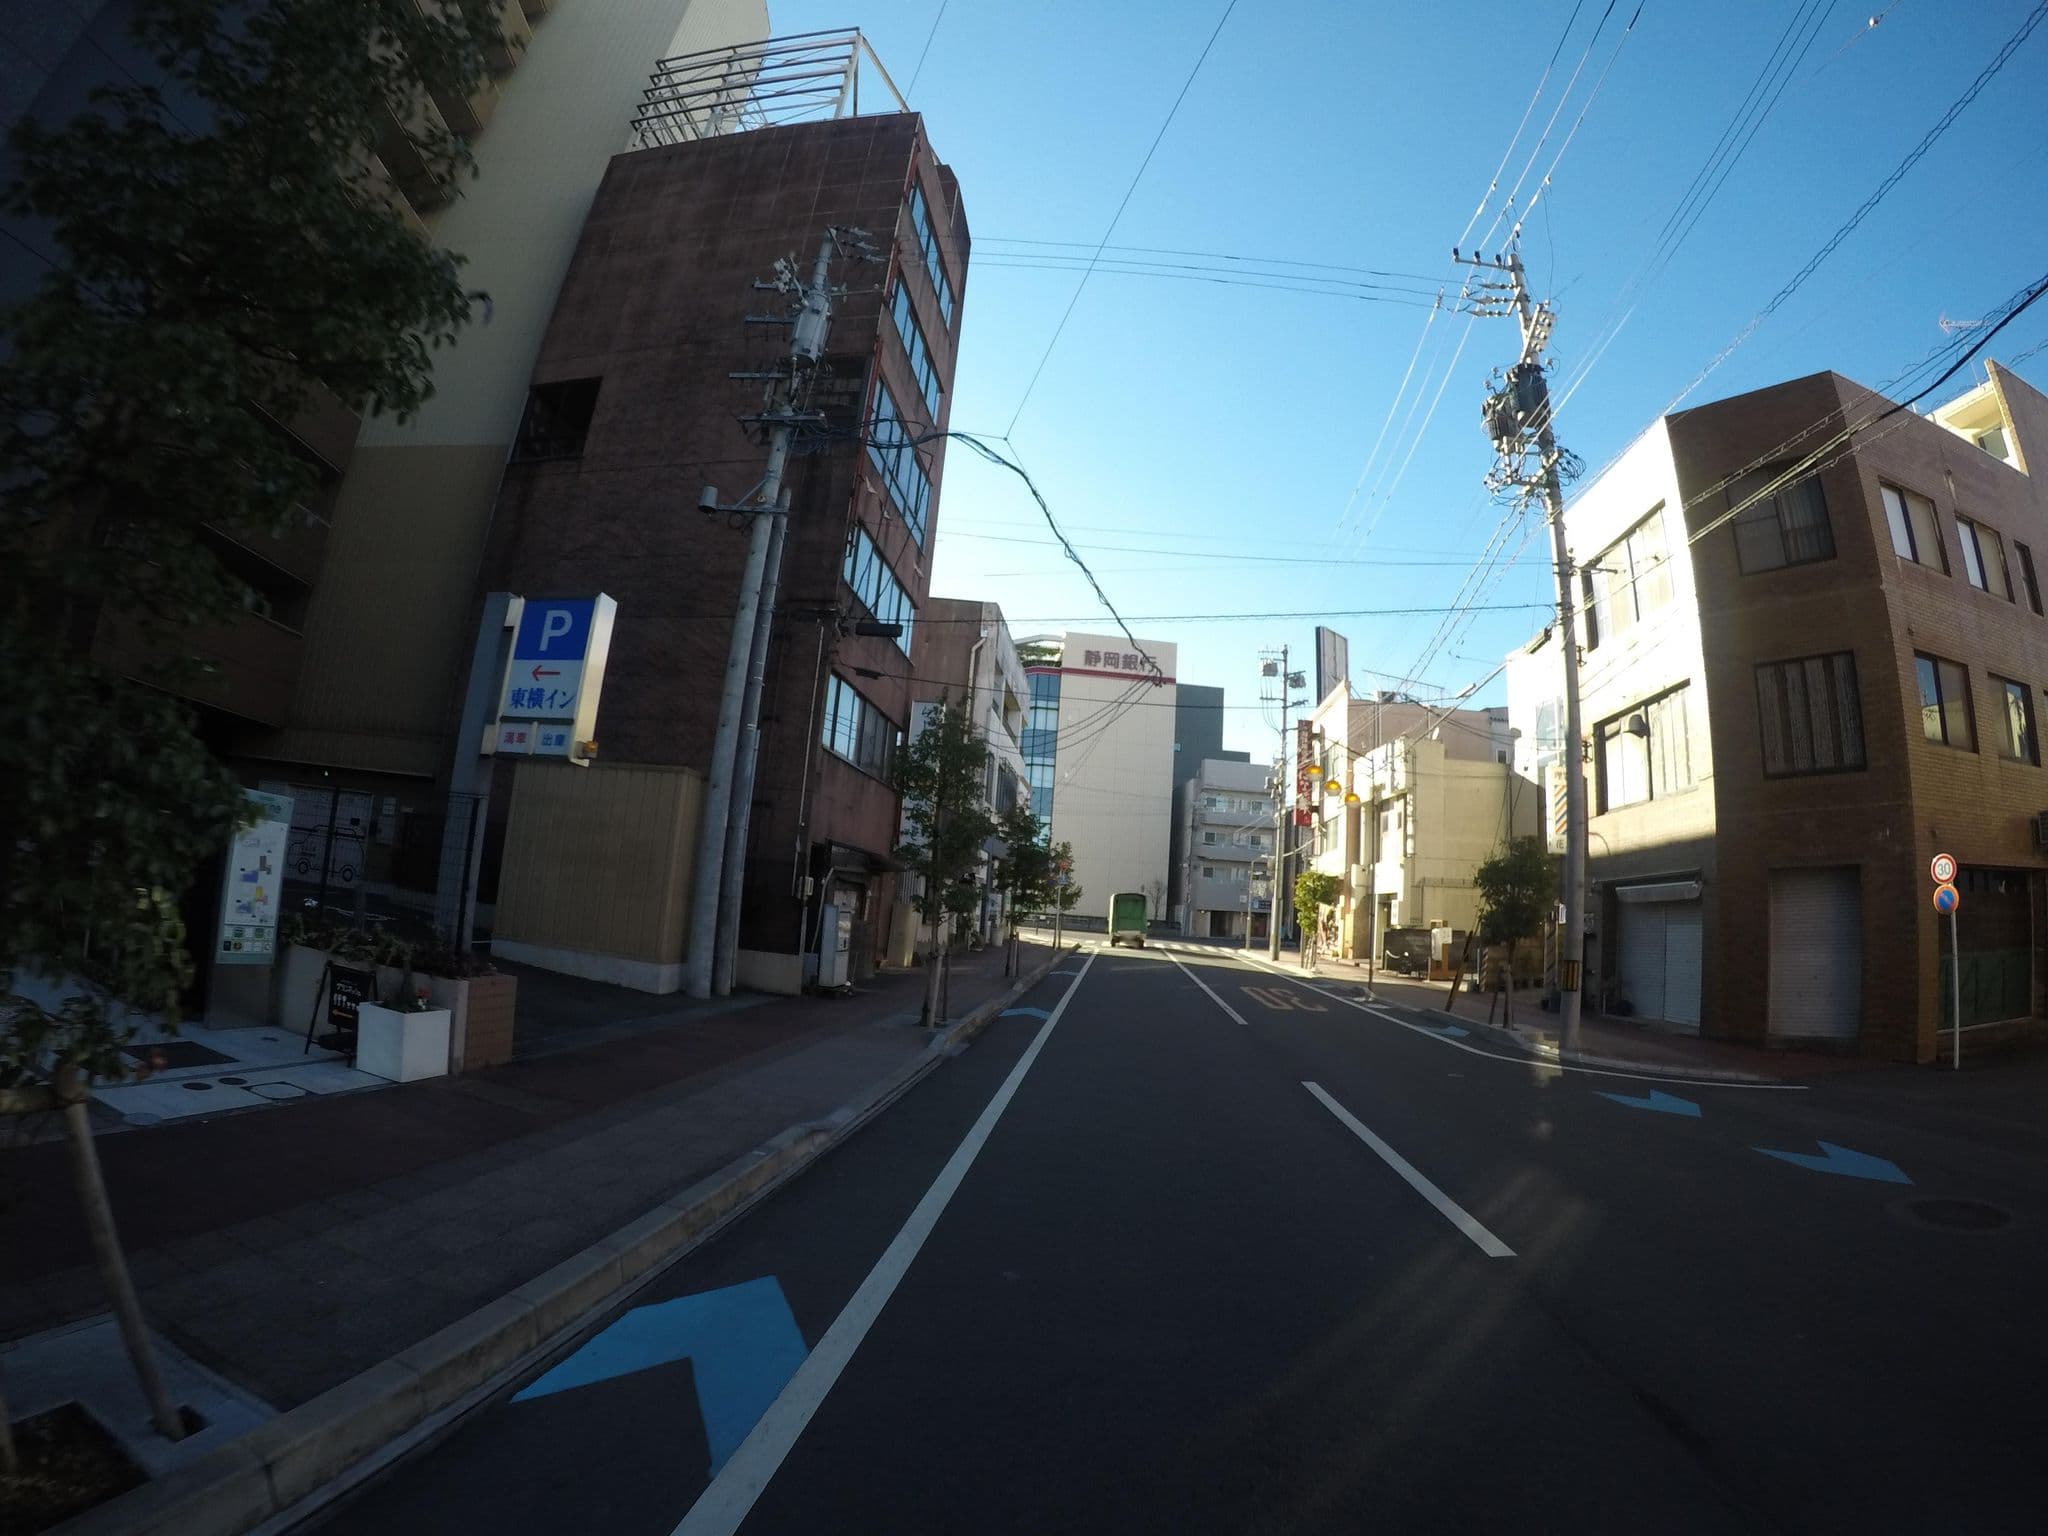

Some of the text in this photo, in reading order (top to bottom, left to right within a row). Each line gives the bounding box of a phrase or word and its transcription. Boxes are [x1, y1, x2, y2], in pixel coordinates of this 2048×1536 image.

[539, 610, 573, 652] P
[1084, 649, 1157, 673] 静岡銀行
[510, 687, 576, 709] 東横イン
[1937, 862, 1951, 876] 30
